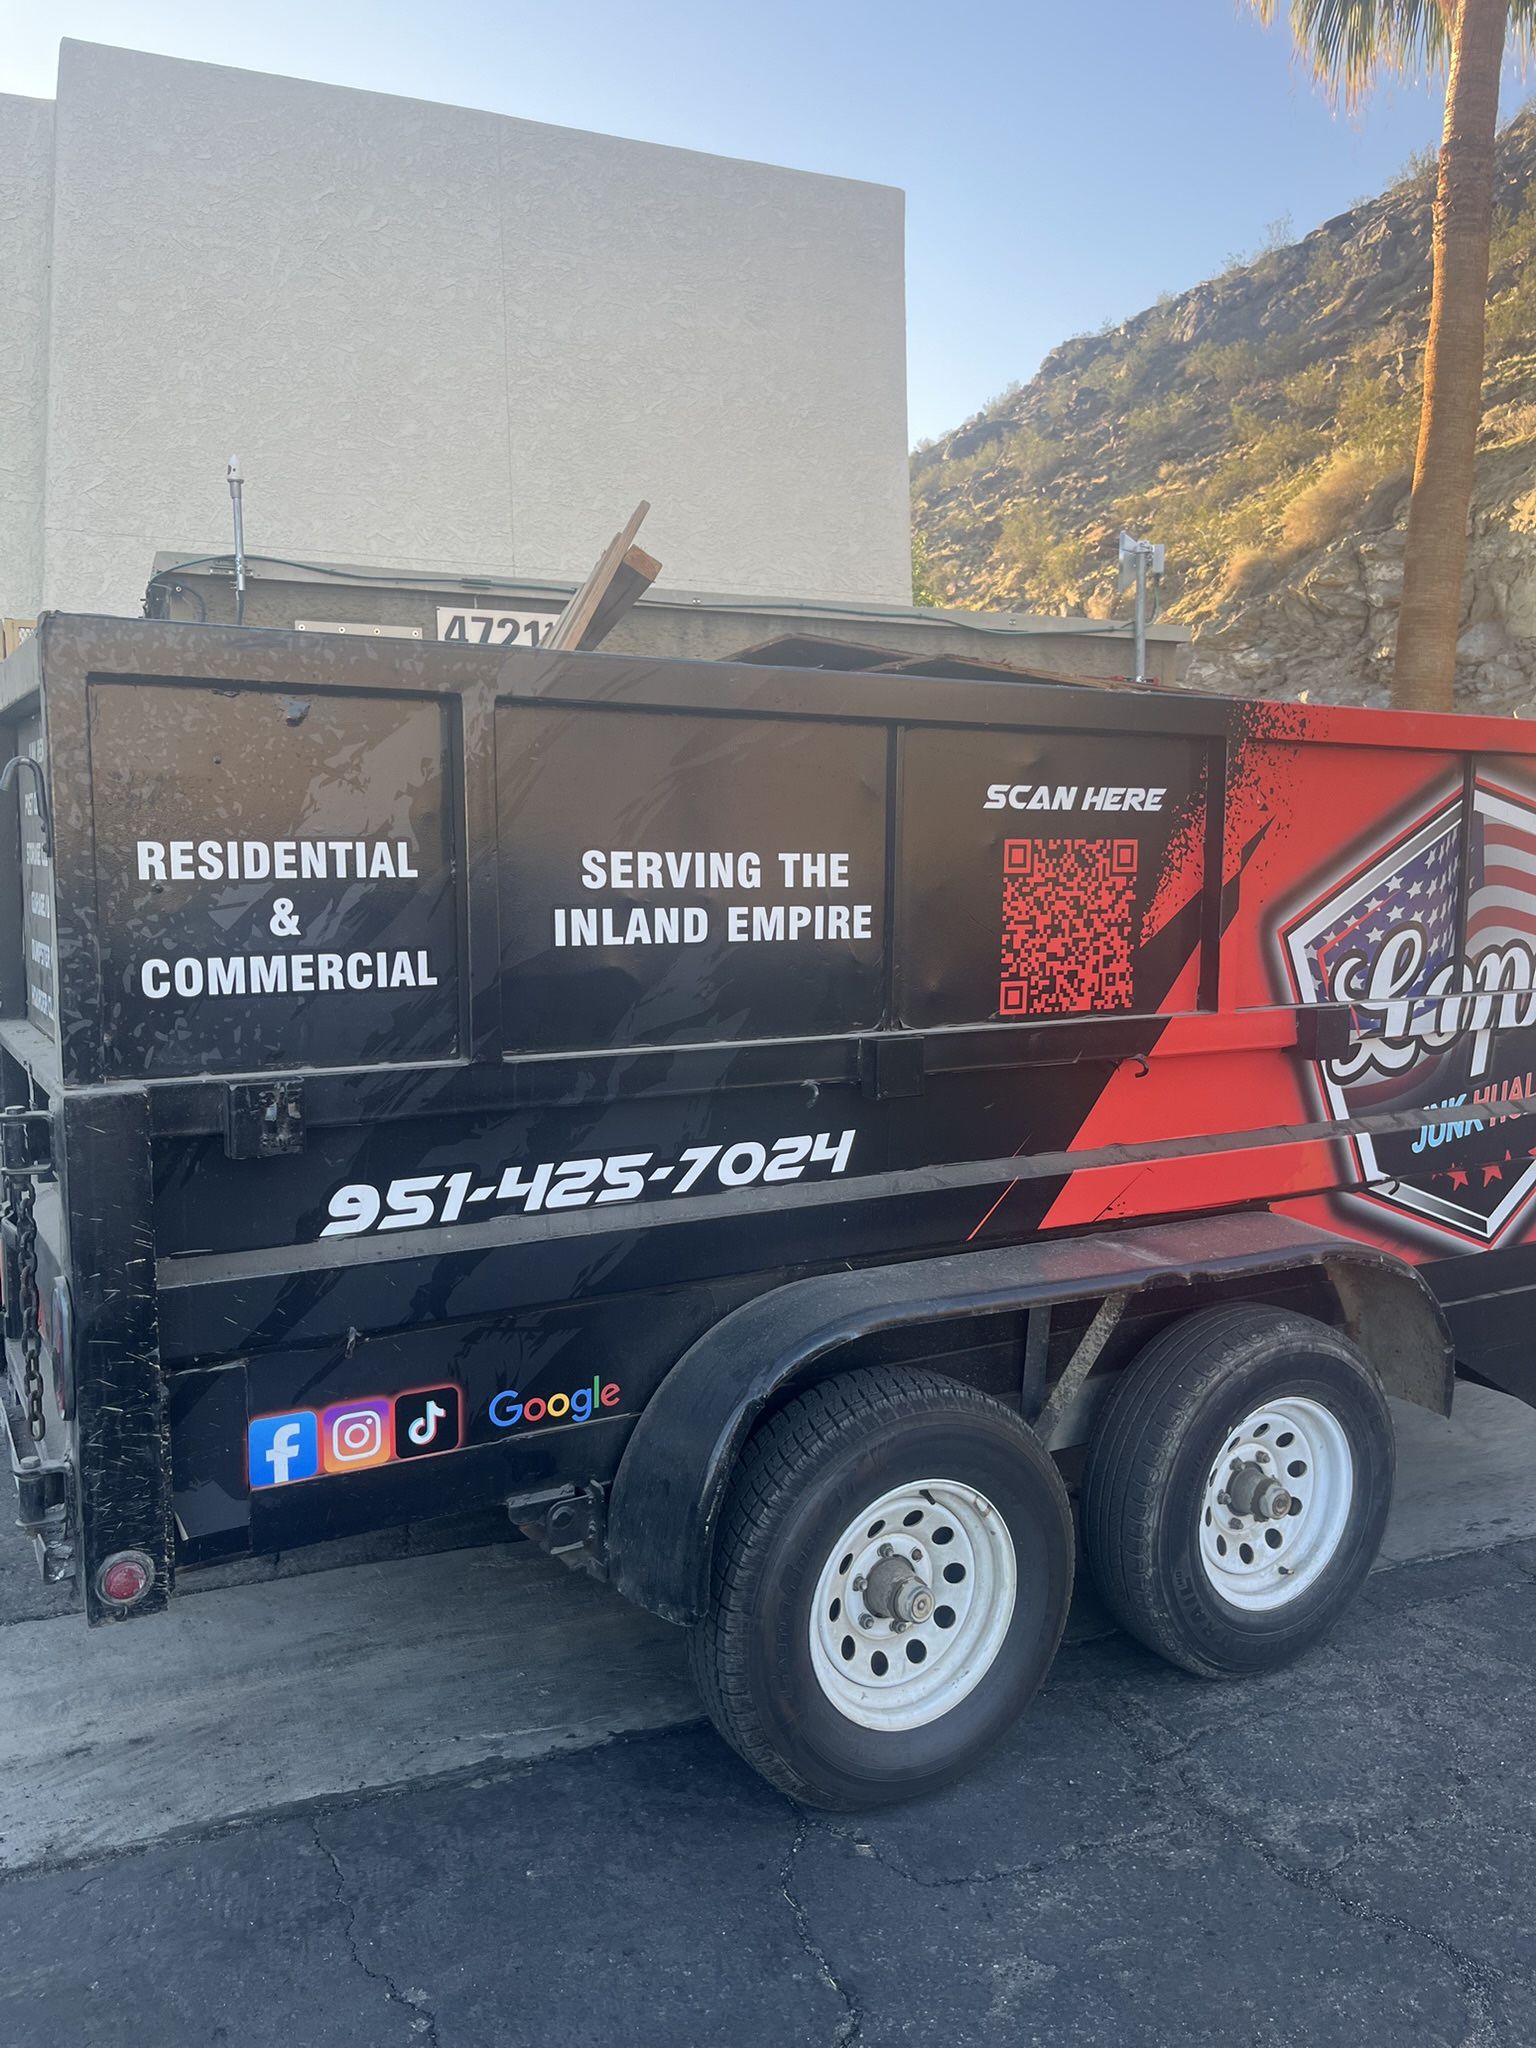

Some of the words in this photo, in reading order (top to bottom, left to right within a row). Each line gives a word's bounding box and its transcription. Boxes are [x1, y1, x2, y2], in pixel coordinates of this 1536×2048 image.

[445, 616, 554, 647] 4721
[983, 785, 1078, 811] SCAN
[1081, 786, 1168, 812] HERE
[136, 841, 419, 881] RESIDENTIAL
[581, 849, 761, 889] SERVING
[778, 852, 849, 888] THE
[269, 898, 302, 937] &
[554, 907, 708, 947] INLAND
[728, 905, 872, 942] EMPIRE
[141, 950, 438, 999] COMMERCIAL
[319, 1129, 856, 1237] 951-425-7024
[488, 1375, 621, 1427] Google
